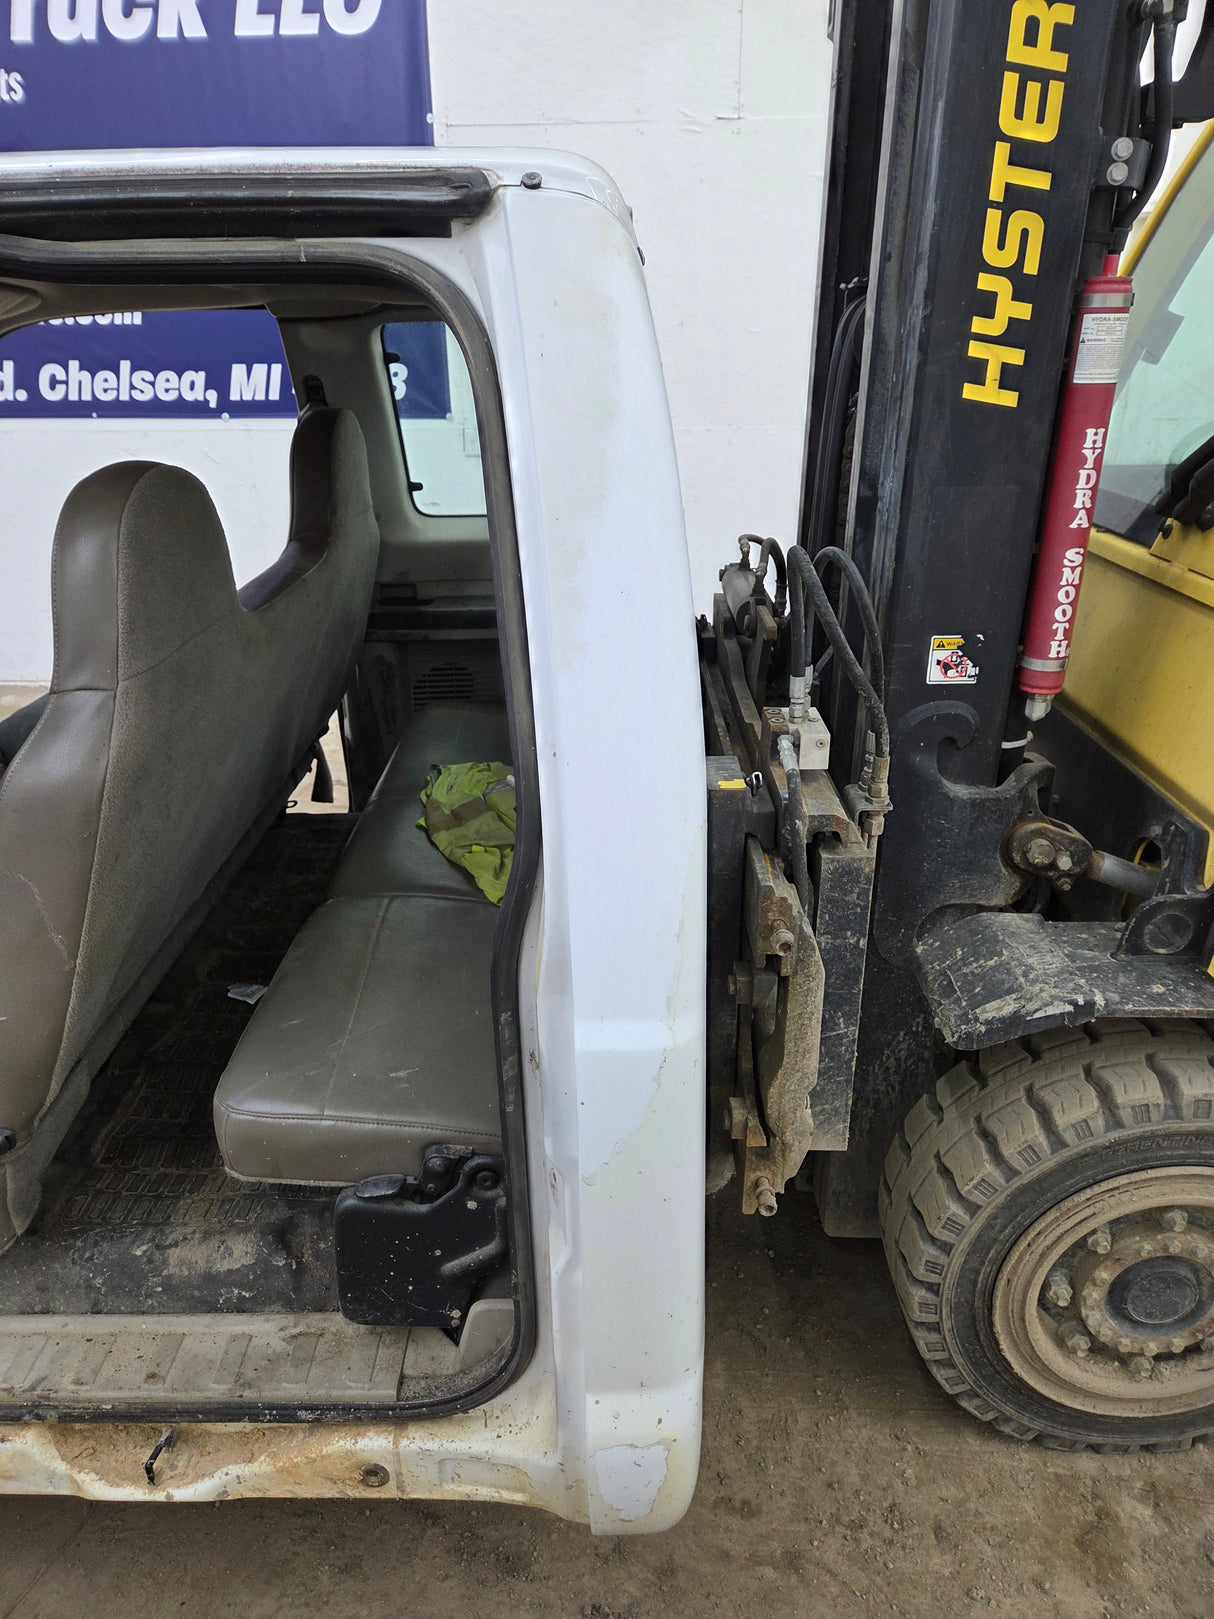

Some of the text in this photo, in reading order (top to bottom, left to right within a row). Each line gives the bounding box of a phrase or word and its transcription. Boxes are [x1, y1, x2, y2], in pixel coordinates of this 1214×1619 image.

[962, 0, 1076, 408] HYSTER
[38, 359, 218, 408] Chelsea,
[229, 363, 282, 401] MI
[1048, 428, 1106, 658] HYDRA SMOOTH
